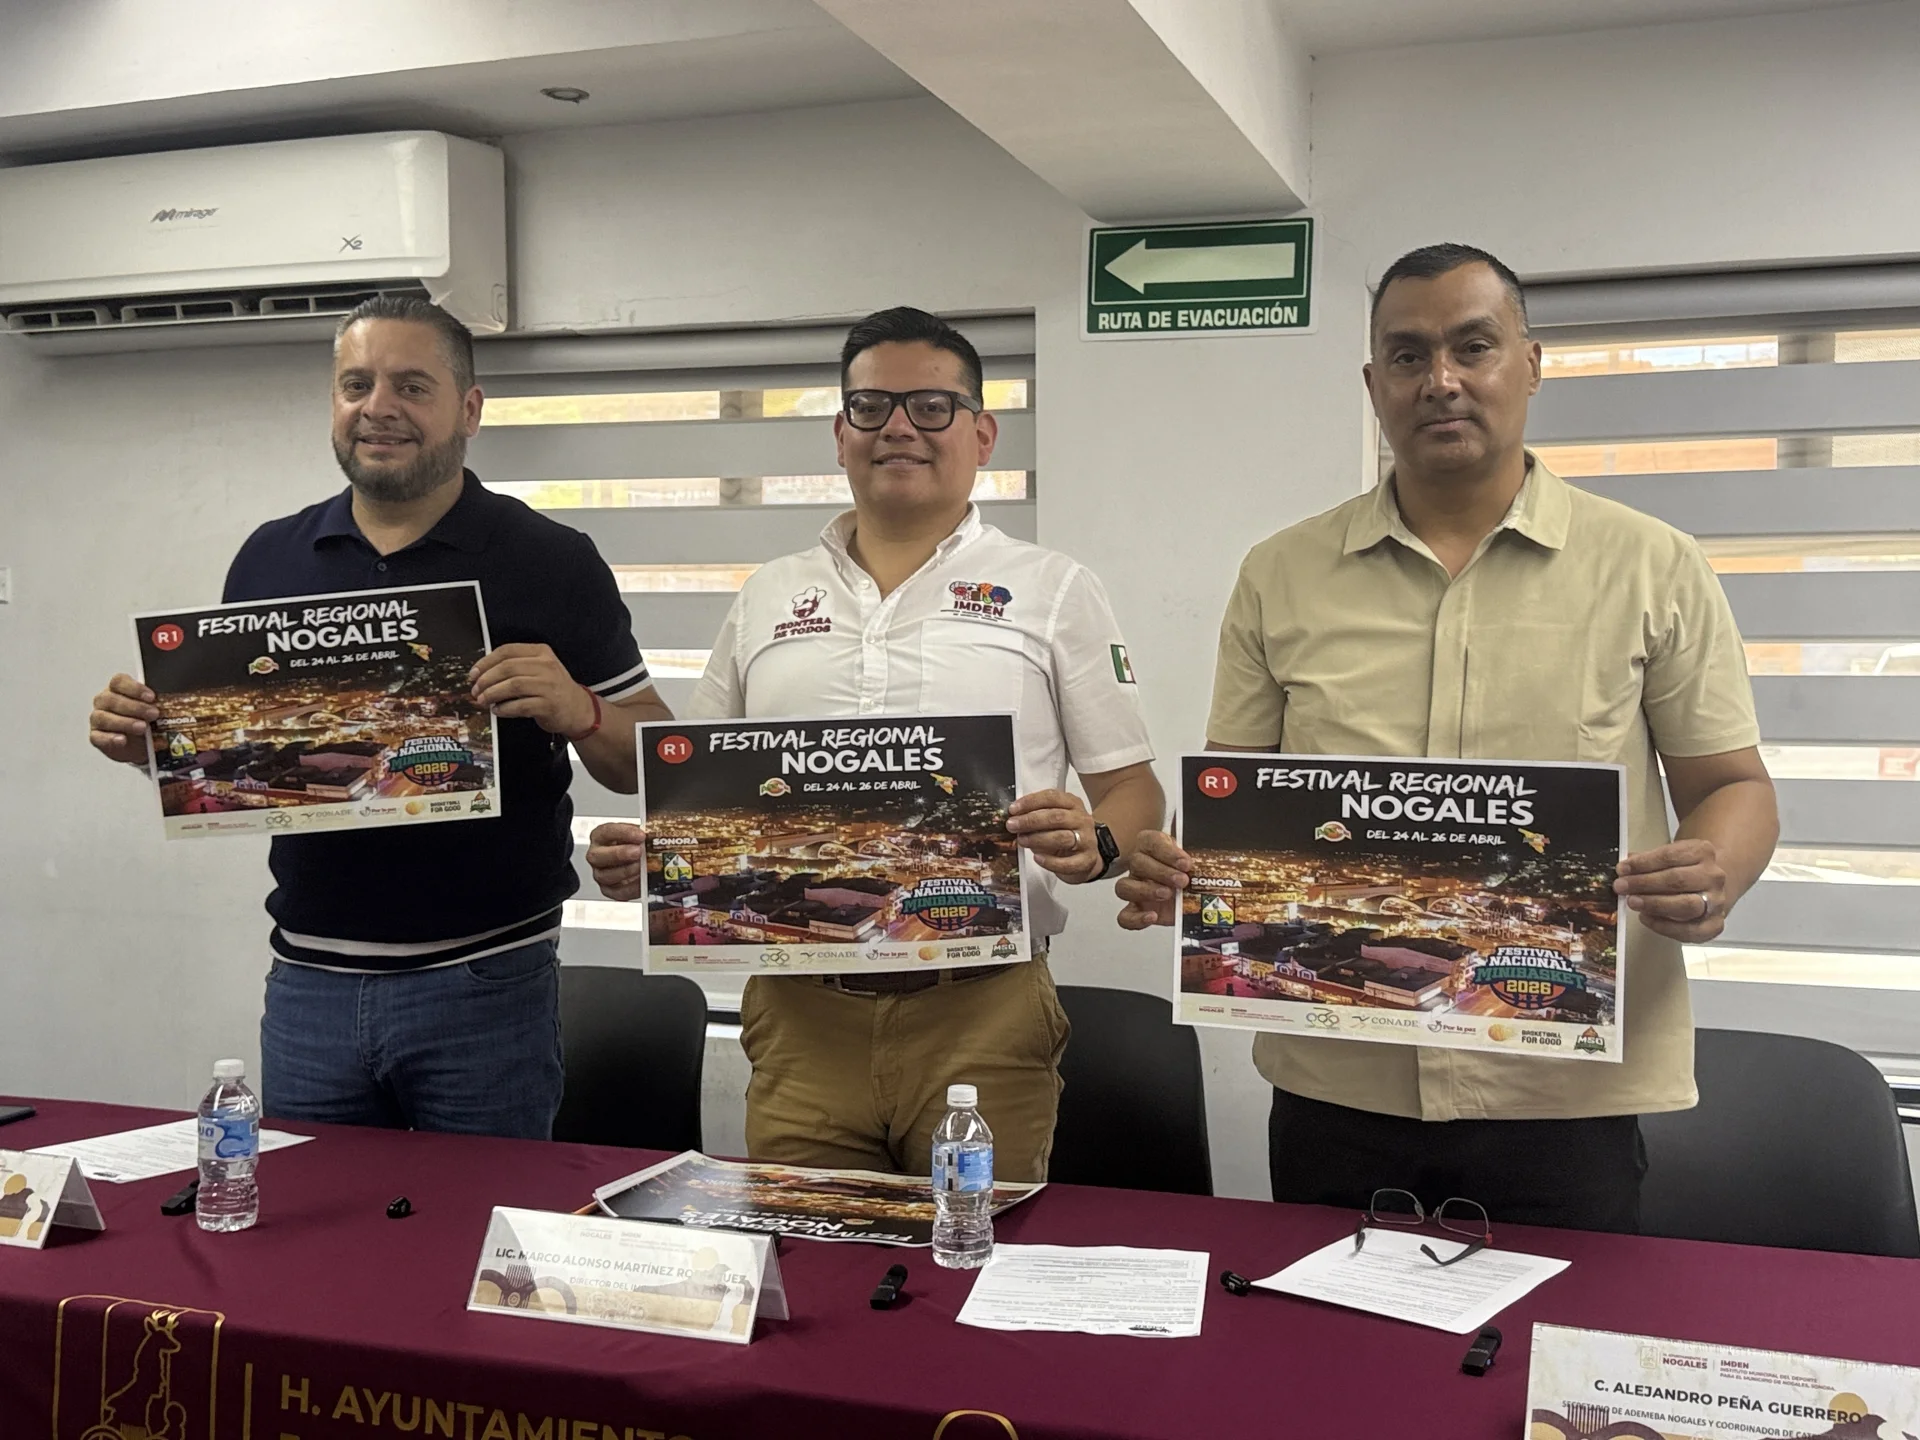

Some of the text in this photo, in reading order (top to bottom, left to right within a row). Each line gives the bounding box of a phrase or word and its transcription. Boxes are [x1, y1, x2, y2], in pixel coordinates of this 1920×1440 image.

[1098, 301, 1298, 330] RUTA DE EVACUACIÓN
[953, 600, 1005, 617] IMDEN
[198, 599, 419, 638] FESTIVAL REGIONAL
[774, 617, 832, 632] FRONTERA
[267, 619, 419, 653] NOGALES
[773, 625, 831, 640] DE TODOS
[290, 658, 310, 668] DEL
[311, 657, 325, 666] 24
[325, 656, 340, 664] AL
[342, 654, 355, 663] 26
[355, 652, 369, 661] DE
[370, 650, 400, 661] ABRIL
[404, 736, 455, 747] FESTIVAL
[709, 725, 946, 752] FESTIVAL REGIONAL
[400, 743, 462, 756] NACIONAL
[391, 751, 473, 771] MINIBASKET
[414, 762, 449, 774] 2026
[782, 747, 944, 774] NOGALES
[803, 780, 921, 791] DEL 24 AL 26 DE ABRIL
[1256, 768, 1538, 799] FESTIVAL REGIONAL
[1341, 794, 1535, 826] NOGALES
[652, 837, 699, 845] SONORA
[1367, 830, 1506, 846] DEL 24 AL 26 DE ABRIL
[920, 878, 976, 888] FESTIVAL
[1191, 877, 1242, 888] SONORA
[914, 885, 984, 898] NACIONAL
[903, 895, 996, 913] MINIBASKET
[930, 906, 968, 918] 2026
[817, 951, 858, 959] CONADE
[1496, 947, 1564, 960] FESTIVAL
[1489, 955, 1573, 972] NACIONAL
[1475, 967, 1585, 989] MINIBASKET
[1506, 979, 1552, 995] 2026
[1371, 1016, 1419, 1028] CONADE
[1521, 1029, 1561, 1038] BASKETBALL
[1521, 1036, 1562, 1045] FOR GOOD
[681, 1211, 844, 1231] NOGALES
[495, 1247, 747, 1285] LIC. MARCO ALONSO MARTÍNEZ ROUEZ
[570, 1277, 611, 1288] DIRECTOR
[613, 1281, 631, 1291] DEL
[1662, 1357, 1708, 1369] NOGALES
[1720, 1359, 1749, 1369] IMDEN
[280, 1375, 693, 1440] H. AYUNTAMIE
[1594, 1379, 1862, 1424] C. ALEJANDRO PEÑA GUERRERO
[1562, 1399, 1610, 1414] SECRETARIO
[1611, 1406, 1623, 1415] DE
[1624, 1408, 1666, 1421] ADEMEBA
[1667, 1414, 1706, 1427] NOGALES
[1708, 1420, 1714, 1428] Y
[1716, 1420, 1781, 1437] COORDINADOR
[1782, 1428, 1794, 1437] DE
